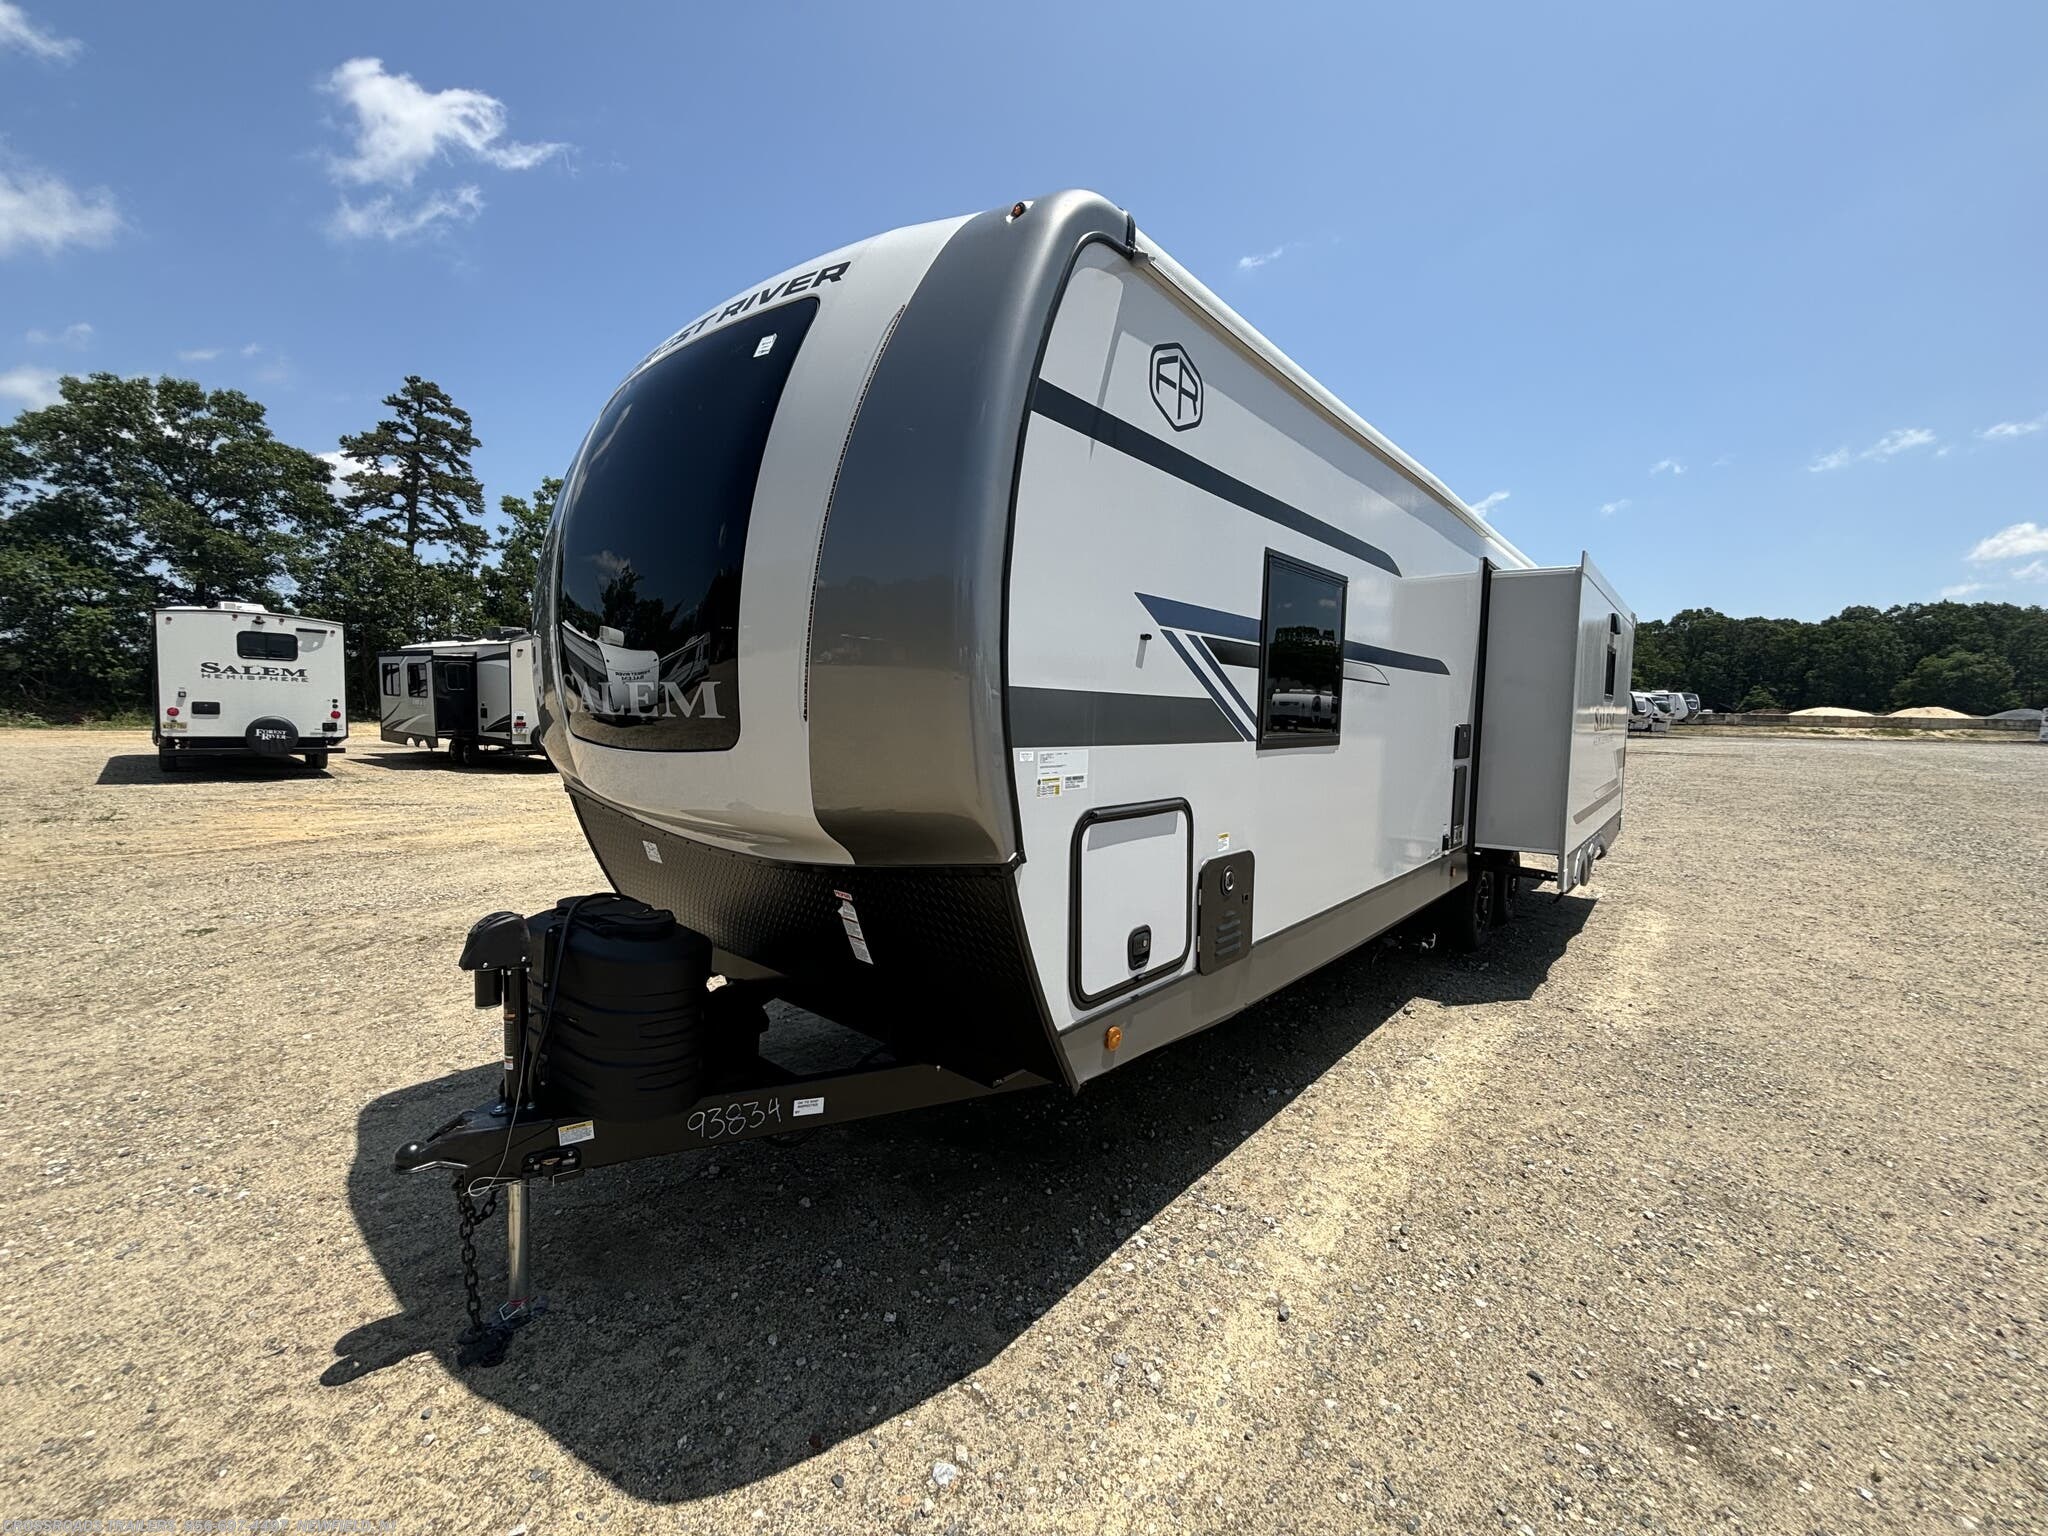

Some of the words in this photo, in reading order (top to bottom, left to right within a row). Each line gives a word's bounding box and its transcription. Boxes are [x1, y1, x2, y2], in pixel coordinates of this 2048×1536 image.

[716, 261, 851, 323] RIVER
[201, 662, 307, 677] SALEM
[202, 673, 308, 683] HEMISPHERE
[563, 673, 726, 719] SALEM
[687, 1097, 782, 1139] 93834
